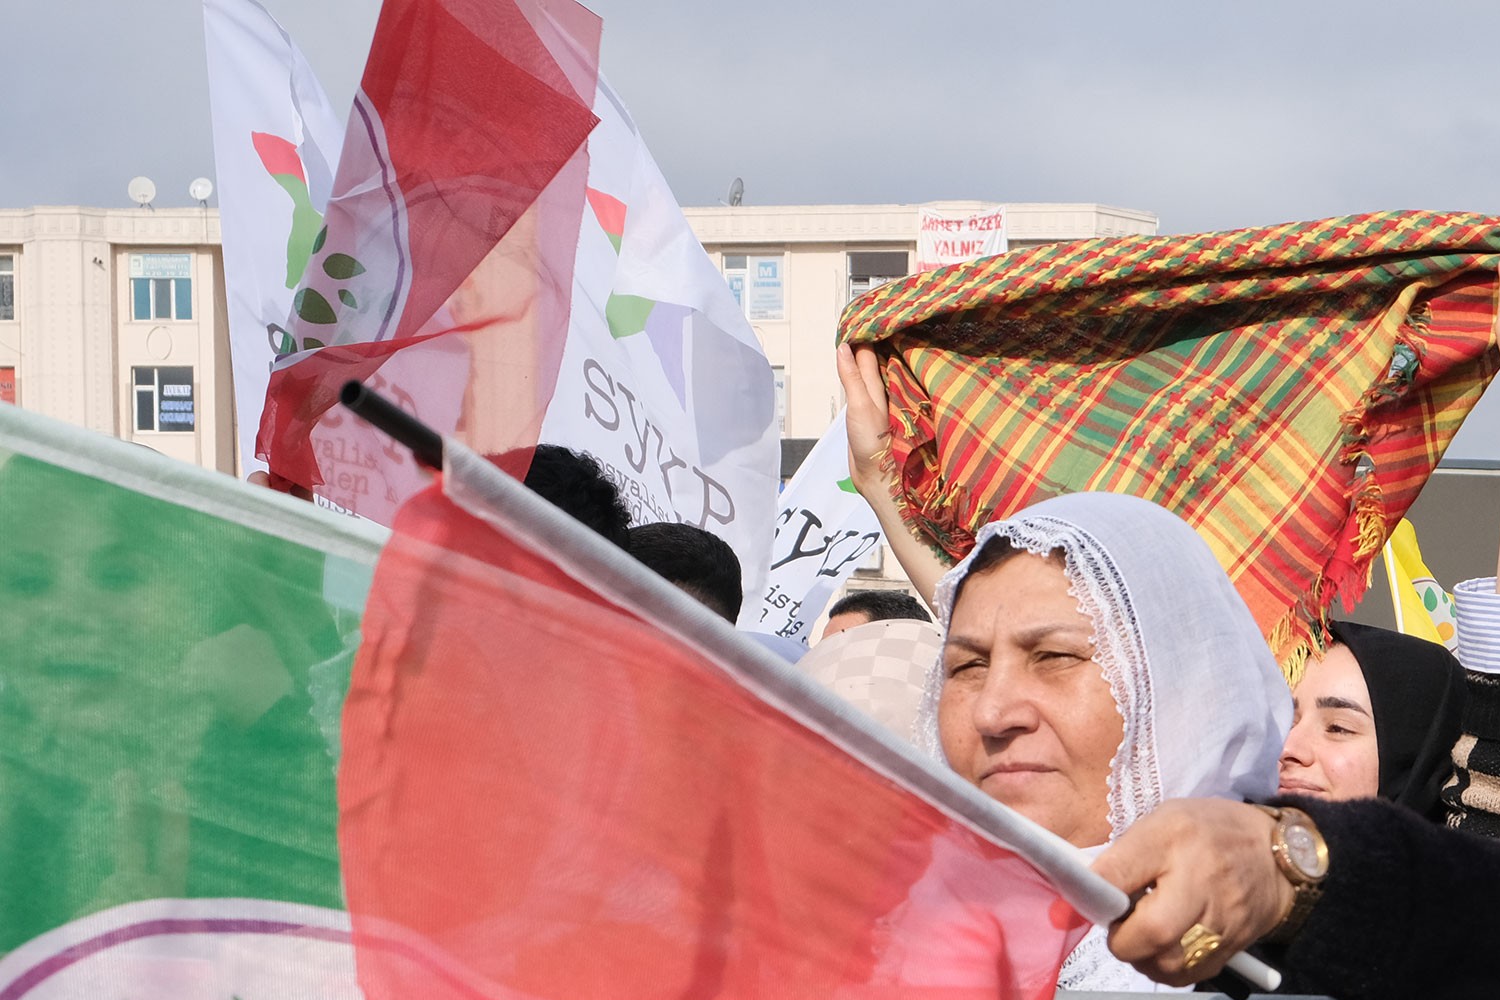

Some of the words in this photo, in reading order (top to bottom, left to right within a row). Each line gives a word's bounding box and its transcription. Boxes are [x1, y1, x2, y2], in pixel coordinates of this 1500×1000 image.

[921, 216, 963, 232] AHMET
[969, 213, 1002, 231] ÖZER
[934, 240, 984, 257] YALNIZ
